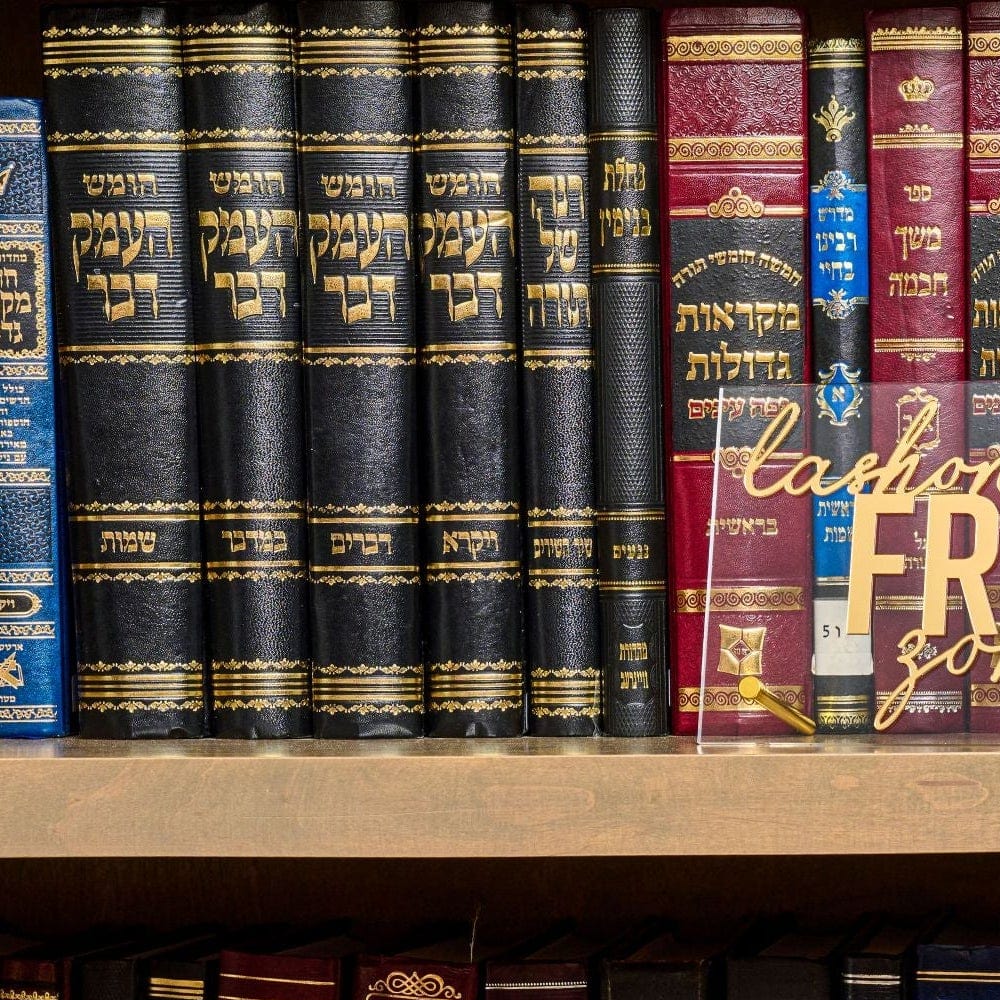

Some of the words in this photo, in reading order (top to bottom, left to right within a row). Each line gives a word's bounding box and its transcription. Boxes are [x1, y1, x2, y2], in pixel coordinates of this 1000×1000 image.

[82, 171, 159, 197] חומש
[208, 171, 285, 195] חומש
[321, 173, 395, 198] חומש
[426, 171, 501, 196] חומש
[903, 185, 932, 202] ספר
[69, 209, 174, 283] העמק
[199, 208, 299, 282] העמק
[308, 210, 410, 284] העמק
[894, 226, 942, 260] משך
[86, 273, 159, 322] דבר
[213, 271, 286, 320] דבר
[324, 274, 396, 324] דבר
[430, 272, 502, 322] דבר
[889, 272, 949, 297] חכמה
[675, 302, 800, 337] מקראות
[686, 341, 791, 380] גדולות
[101, 531, 156, 553] שמות
[222, 530, 288, 553] במדבר
[330, 533, 392, 555] דברים
[443, 530, 499, 560] ויקרא
